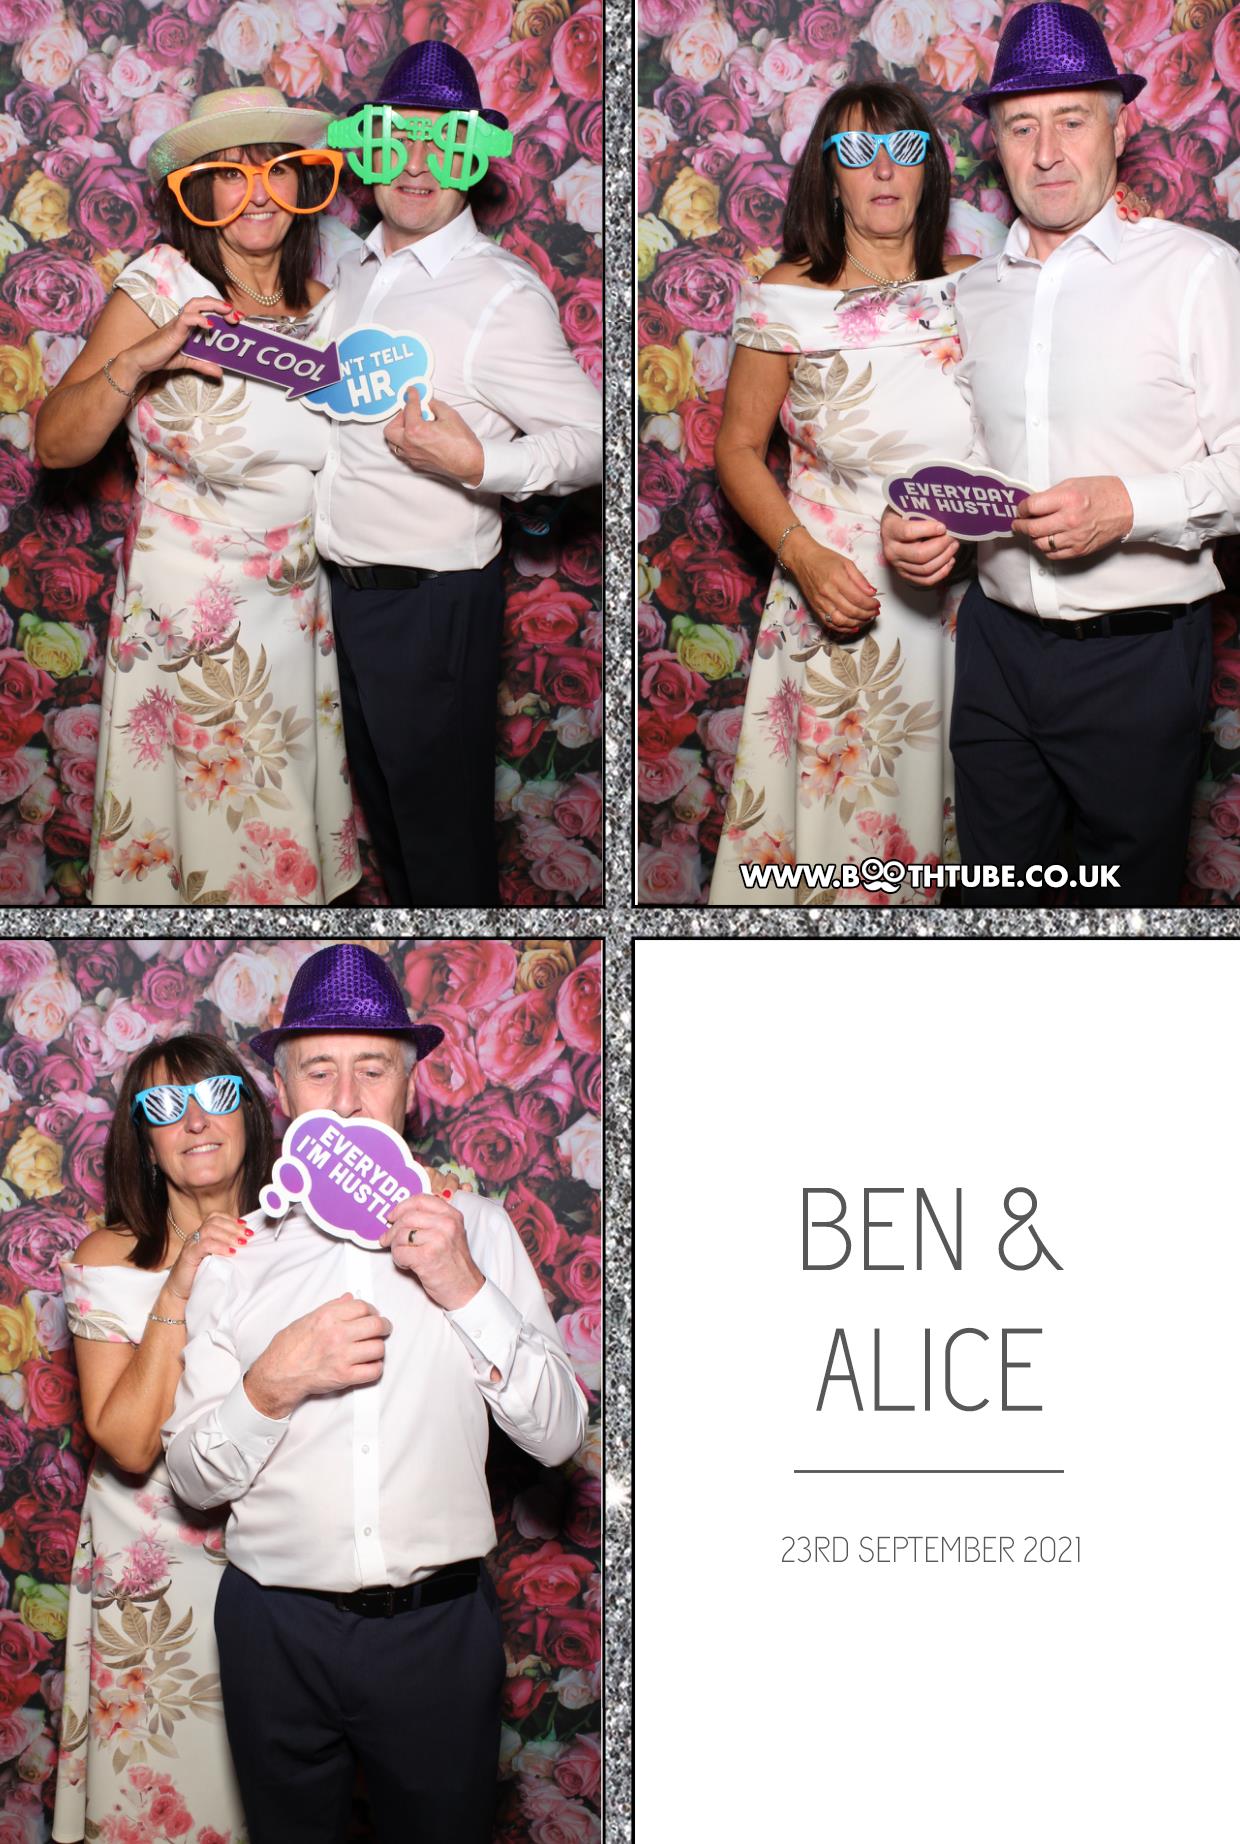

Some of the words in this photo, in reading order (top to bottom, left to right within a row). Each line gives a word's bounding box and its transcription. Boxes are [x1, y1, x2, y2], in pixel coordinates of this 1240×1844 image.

[193, 329, 257, 358] NOT
[256, 346, 326, 382] COOL
[340, 356, 365, 377] N'T
[369, 343, 414, 368] TELL
[346, 369, 396, 408] HR
[899, 495, 931, 511] I'M
[903, 481, 1015, 504] EVERYDAY
[296, 1135, 332, 1170] I'M
[328, 1162, 393, 1228] HUSTL
[319, 1125, 411, 1204] EVERYDA
